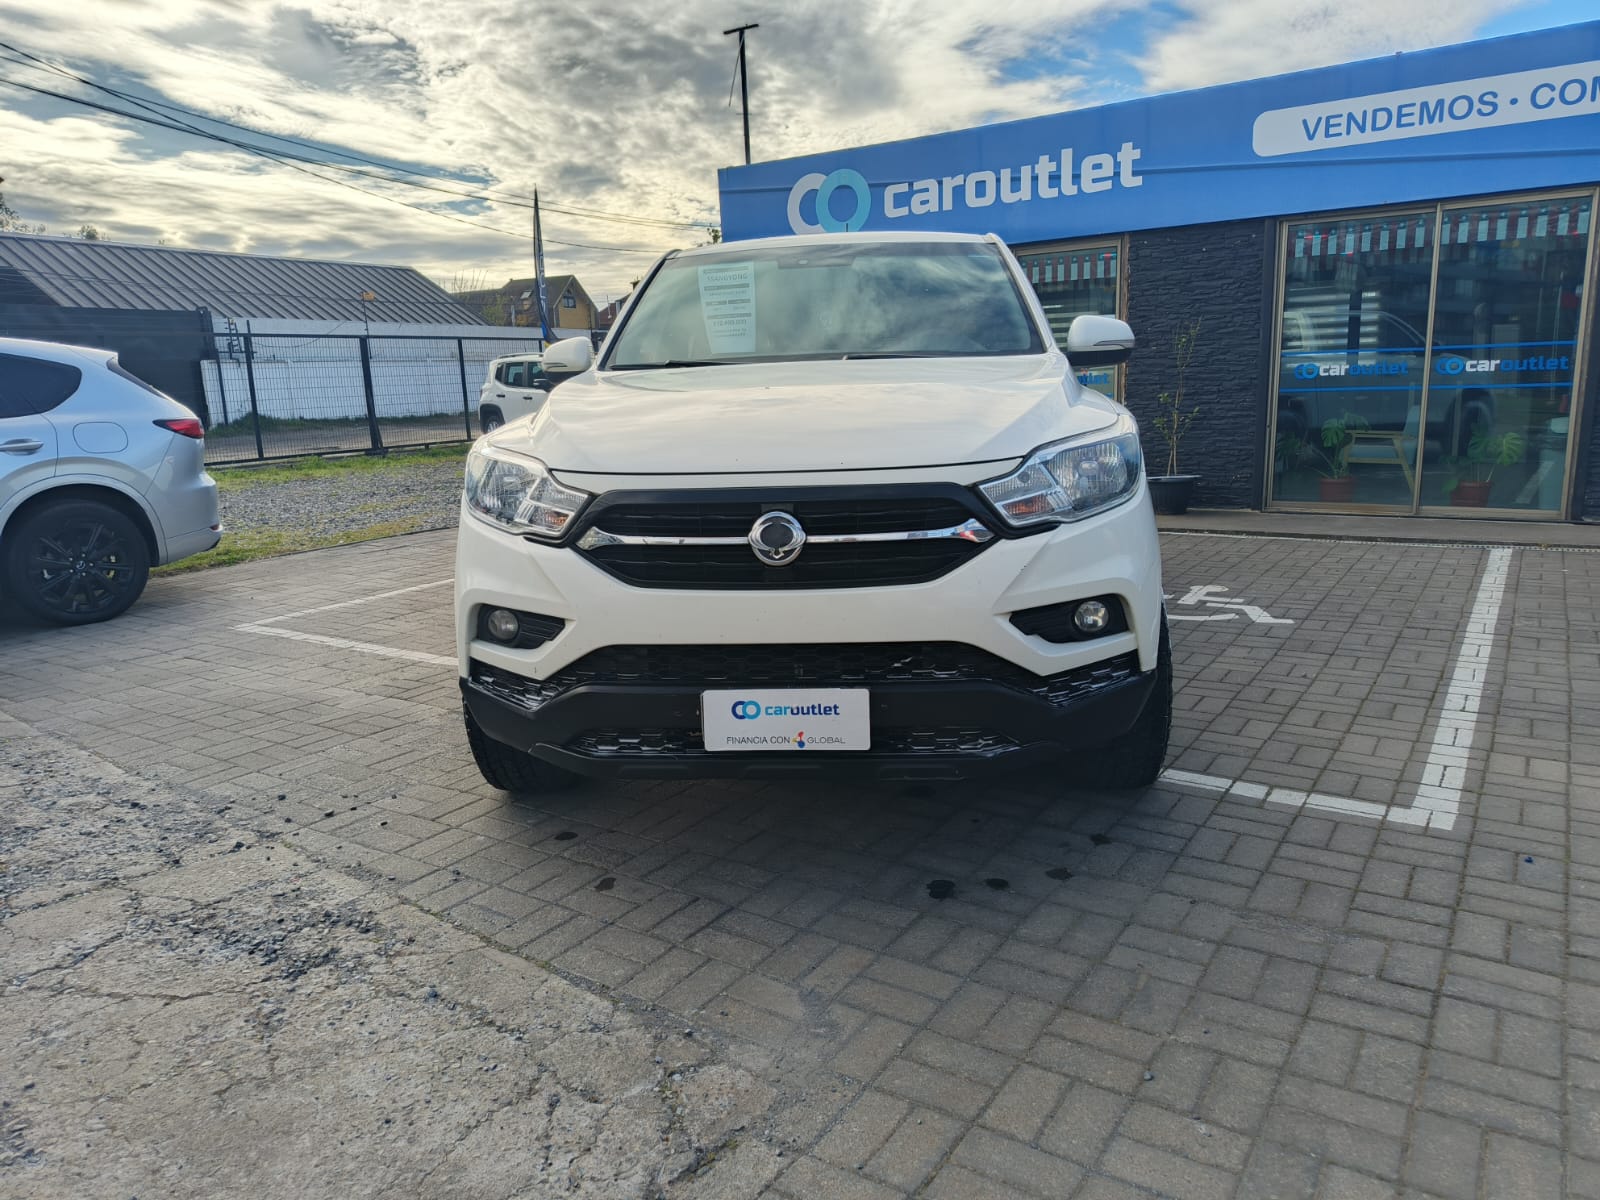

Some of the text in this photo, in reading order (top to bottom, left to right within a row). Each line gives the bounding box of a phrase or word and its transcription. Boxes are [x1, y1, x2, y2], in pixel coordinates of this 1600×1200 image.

[1302, 90, 1499, 142] VENDEMOS
[884, 141, 1143, 218] caroutlet
[1319, 361, 1408, 377] caroutlet
[1465, 356, 1569, 373] caroutlet
[764, 703, 840, 716] caroutlet
[726, 736, 846, 744] FINANCIA CON GLOBAL
